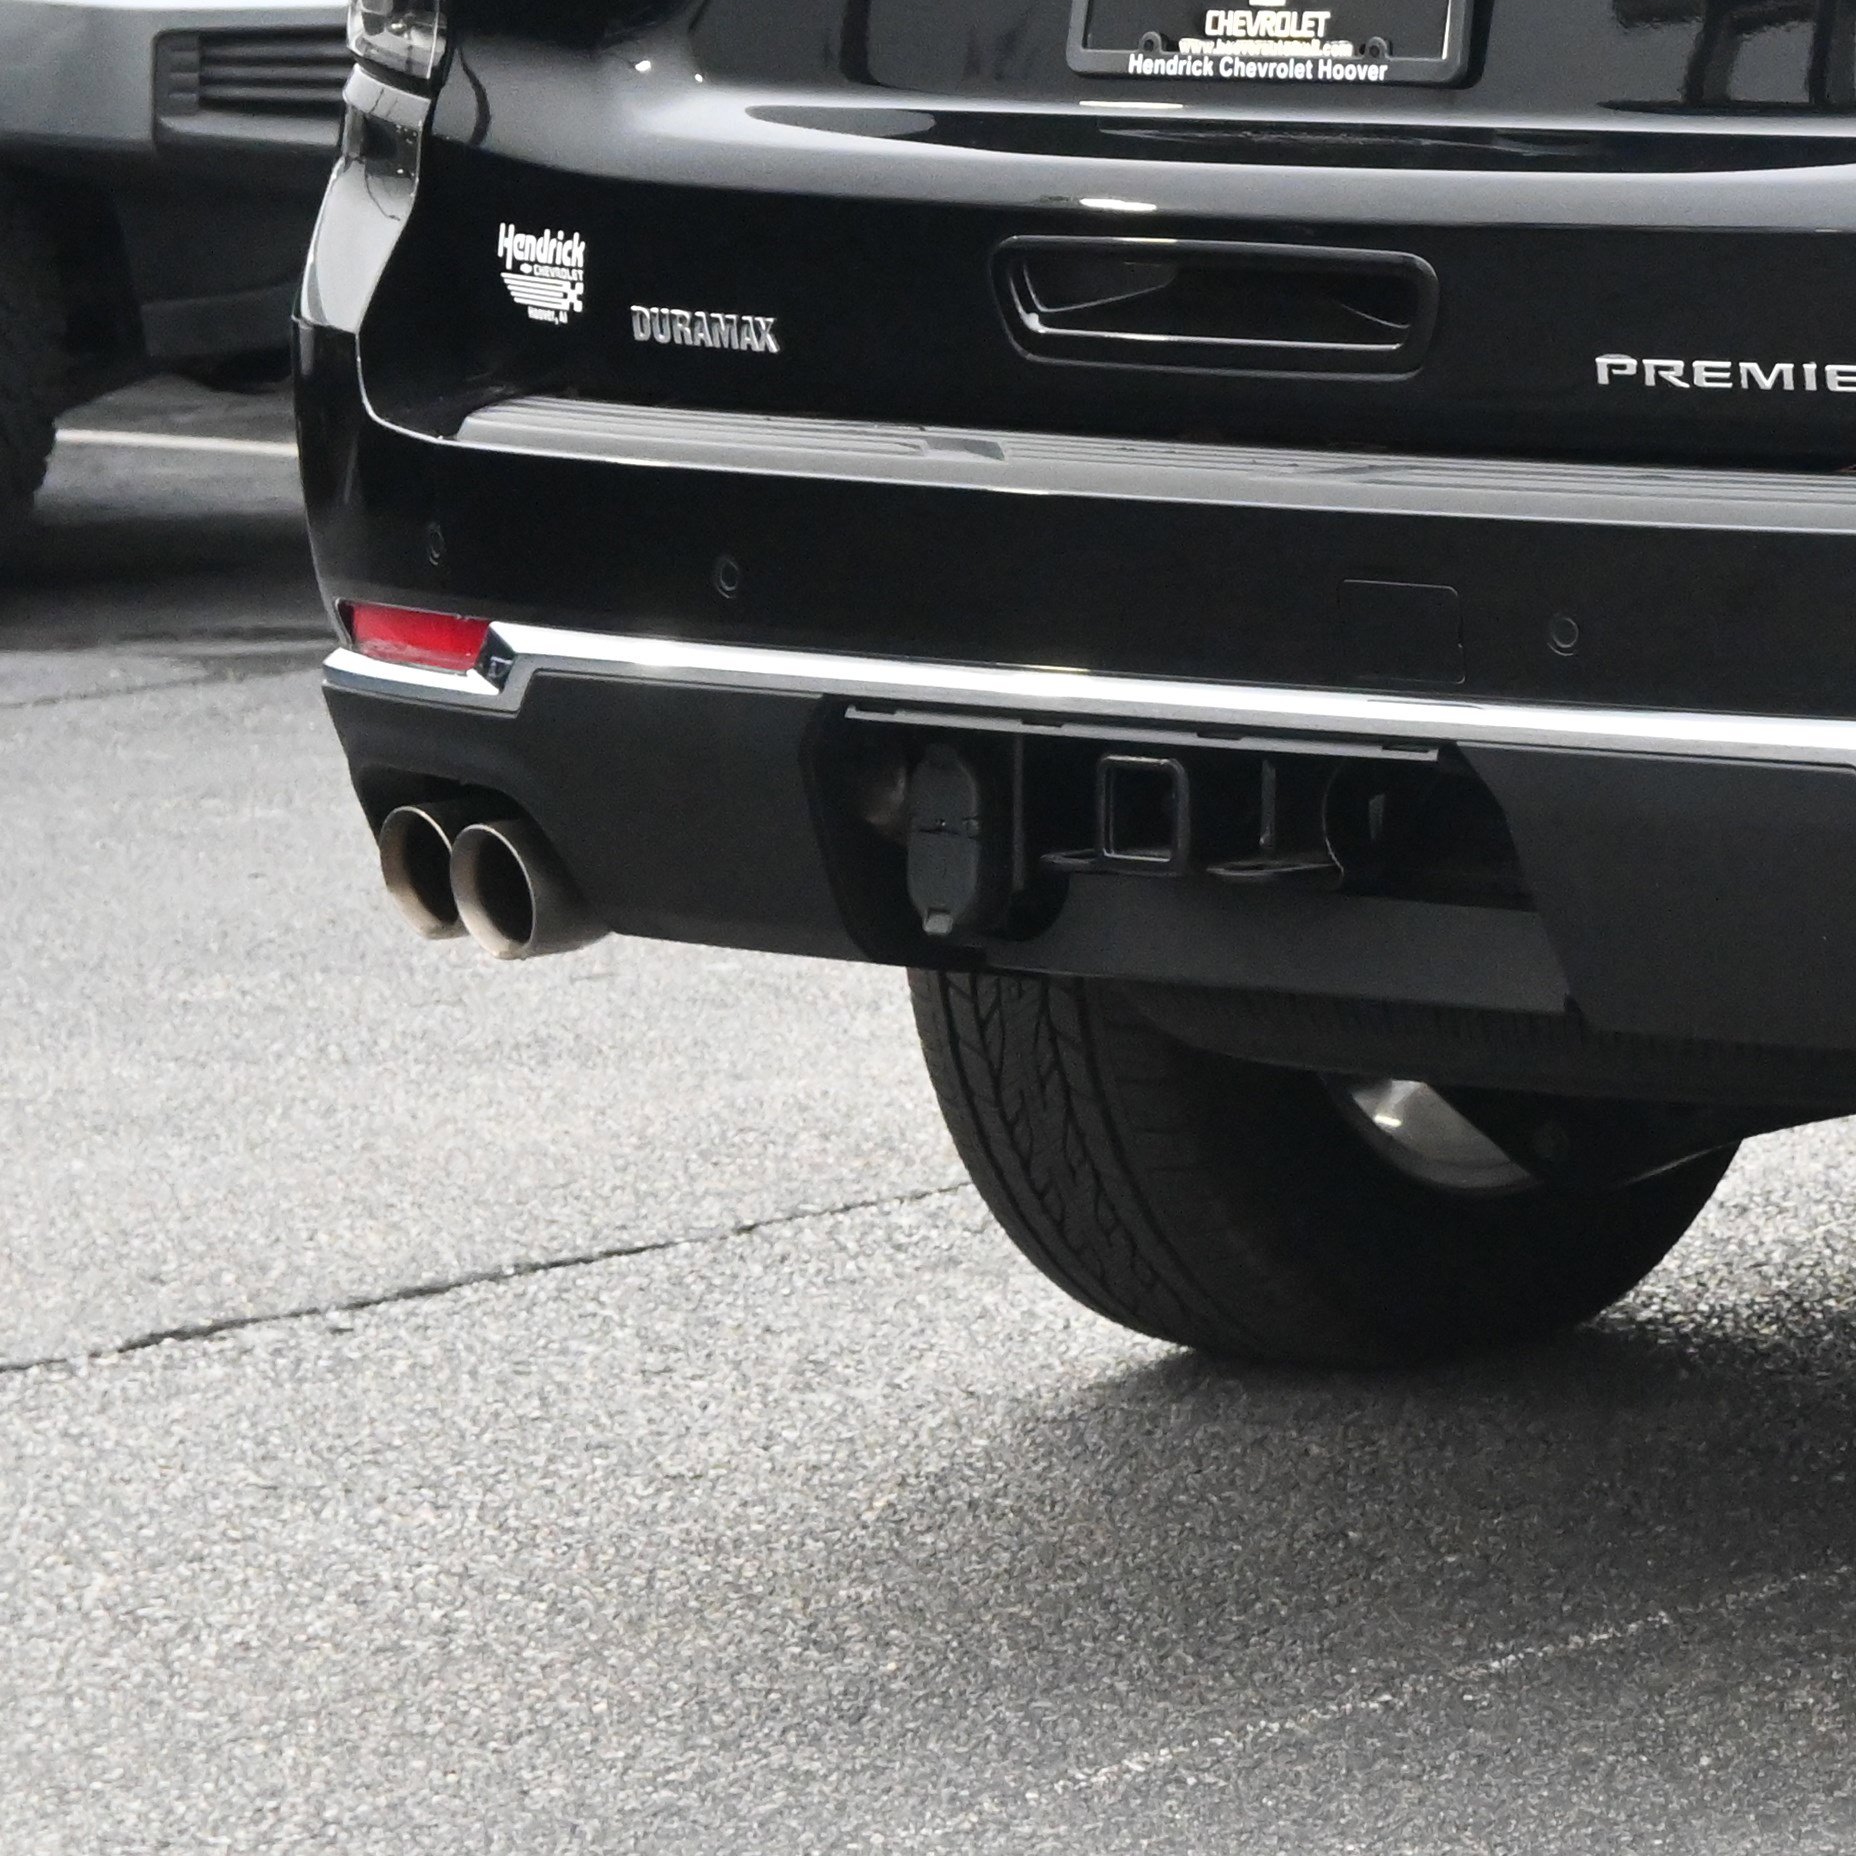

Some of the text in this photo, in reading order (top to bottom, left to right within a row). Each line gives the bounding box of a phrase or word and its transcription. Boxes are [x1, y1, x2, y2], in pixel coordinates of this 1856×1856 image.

[1204, 10, 1331, 38] CHEVROLET
[1128, 53, 1388, 82] Hendrick Chevrolet Hoover
[497, 222, 586, 271] Hendrick
[533, 263, 584, 282] CHEVROLET
[630, 304, 781, 354] DURAMAX
